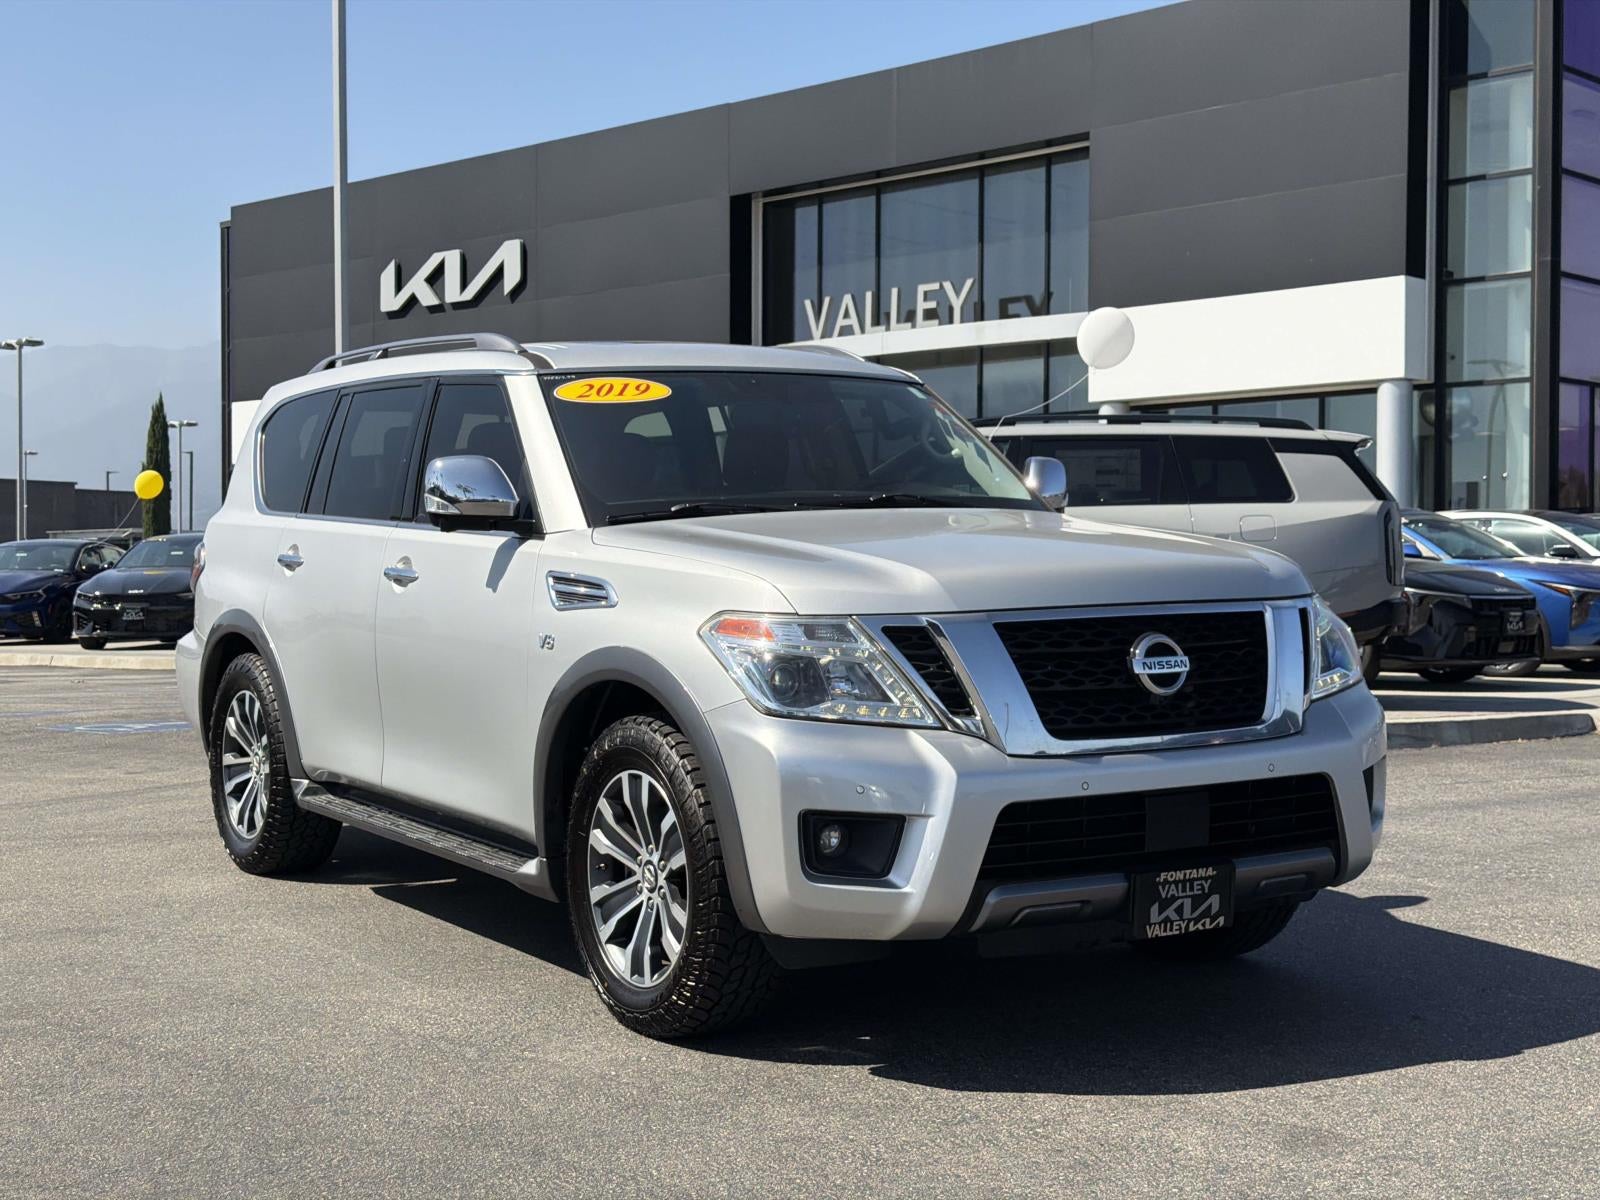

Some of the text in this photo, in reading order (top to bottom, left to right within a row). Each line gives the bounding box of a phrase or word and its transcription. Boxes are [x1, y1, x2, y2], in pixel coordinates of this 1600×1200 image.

[380, 239, 523, 312] KIA
[804, 277, 976, 341] VALLEY
[576, 382, 651, 399] 2019
[1142, 659, 1188, 671] NISSAN
[1159, 867, 1213, 882] FONTANA
[1158, 879, 1212, 899] VALLEY
[1150, 894, 1220, 923] KIA
[1145, 915, 1225, 938] VALLEY KIA
